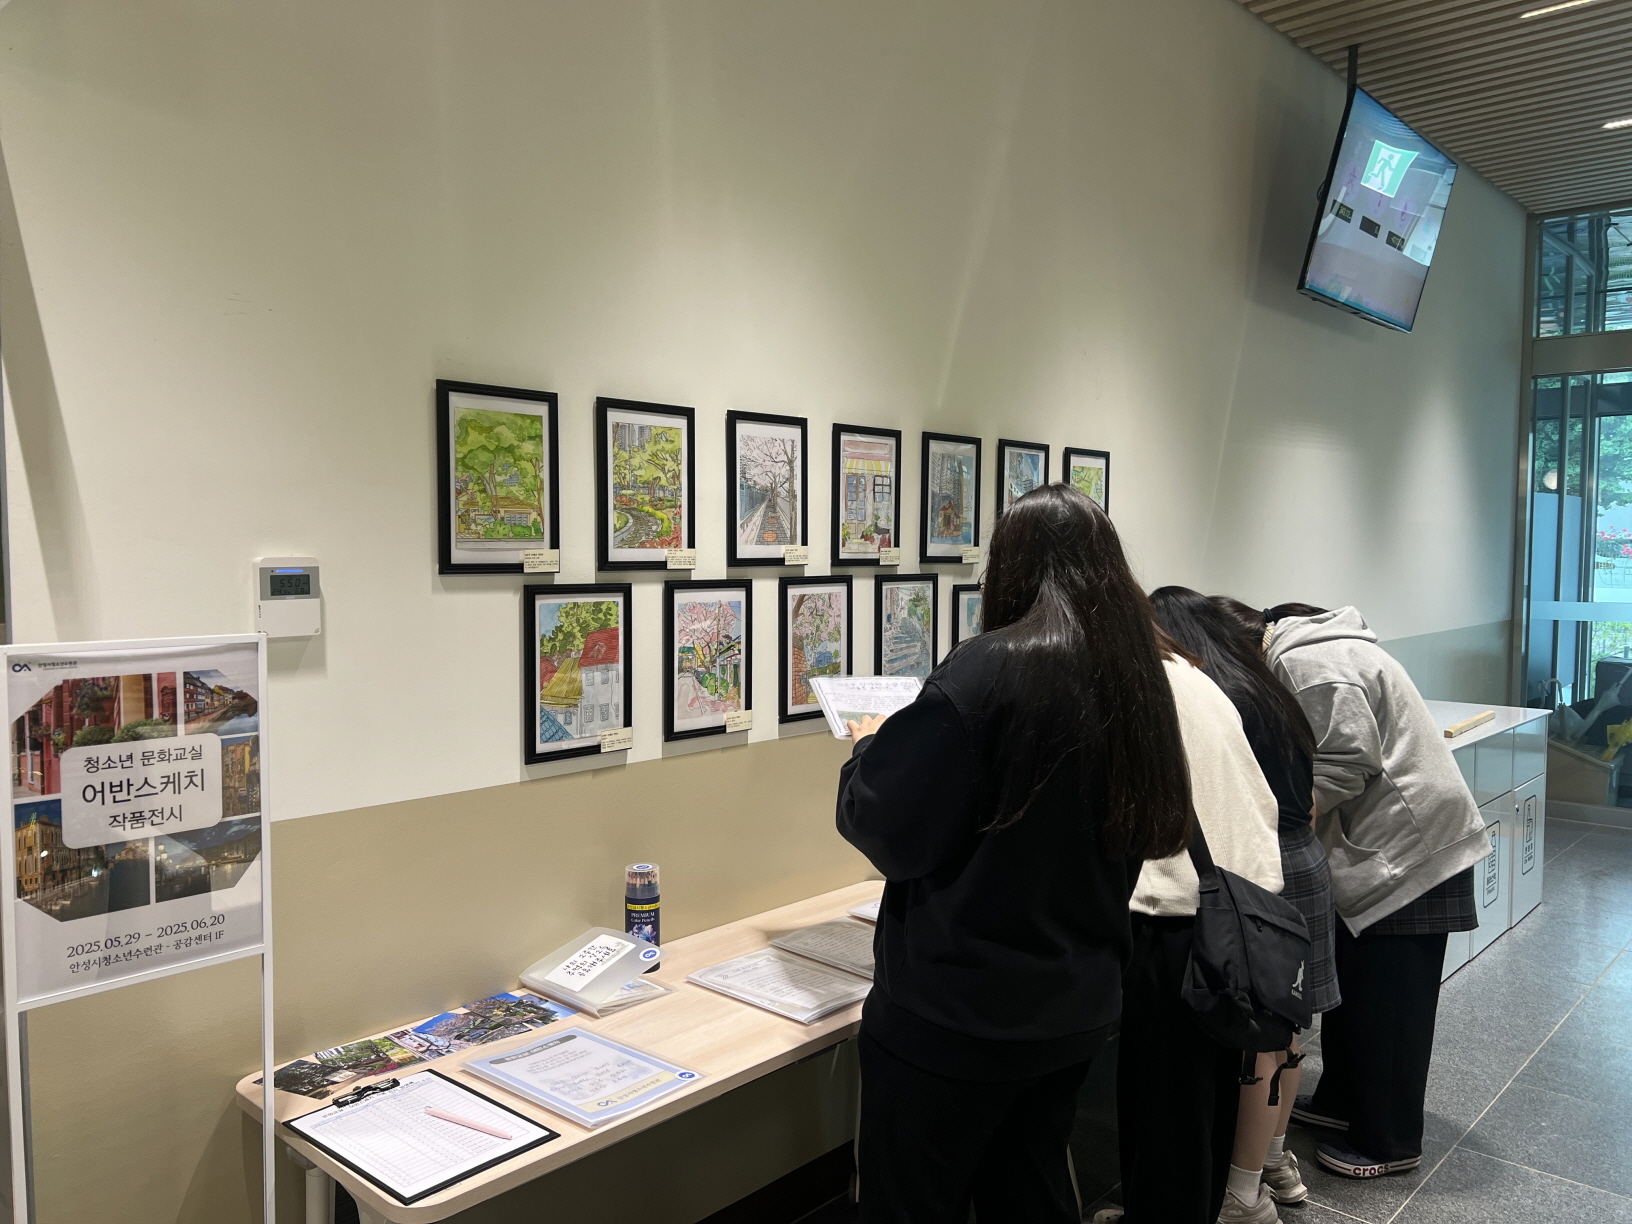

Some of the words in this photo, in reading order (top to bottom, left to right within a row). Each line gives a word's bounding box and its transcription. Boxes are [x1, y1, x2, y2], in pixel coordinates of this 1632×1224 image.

[83, 752, 134, 774] 청소년
[139, 744, 203, 766] 문화교실
[81, 768, 205, 806] 어반스케치
[108, 804, 183, 831] 작품전시
[66, 932, 141, 958] 2025.05.29
[156, 913, 226, 939] 2025.06.20
[69, 944, 163, 974] 안성시청소년수련관
[172, 932, 213, 950] 공감센터
[1352, 1163, 1389, 1176] crocs
